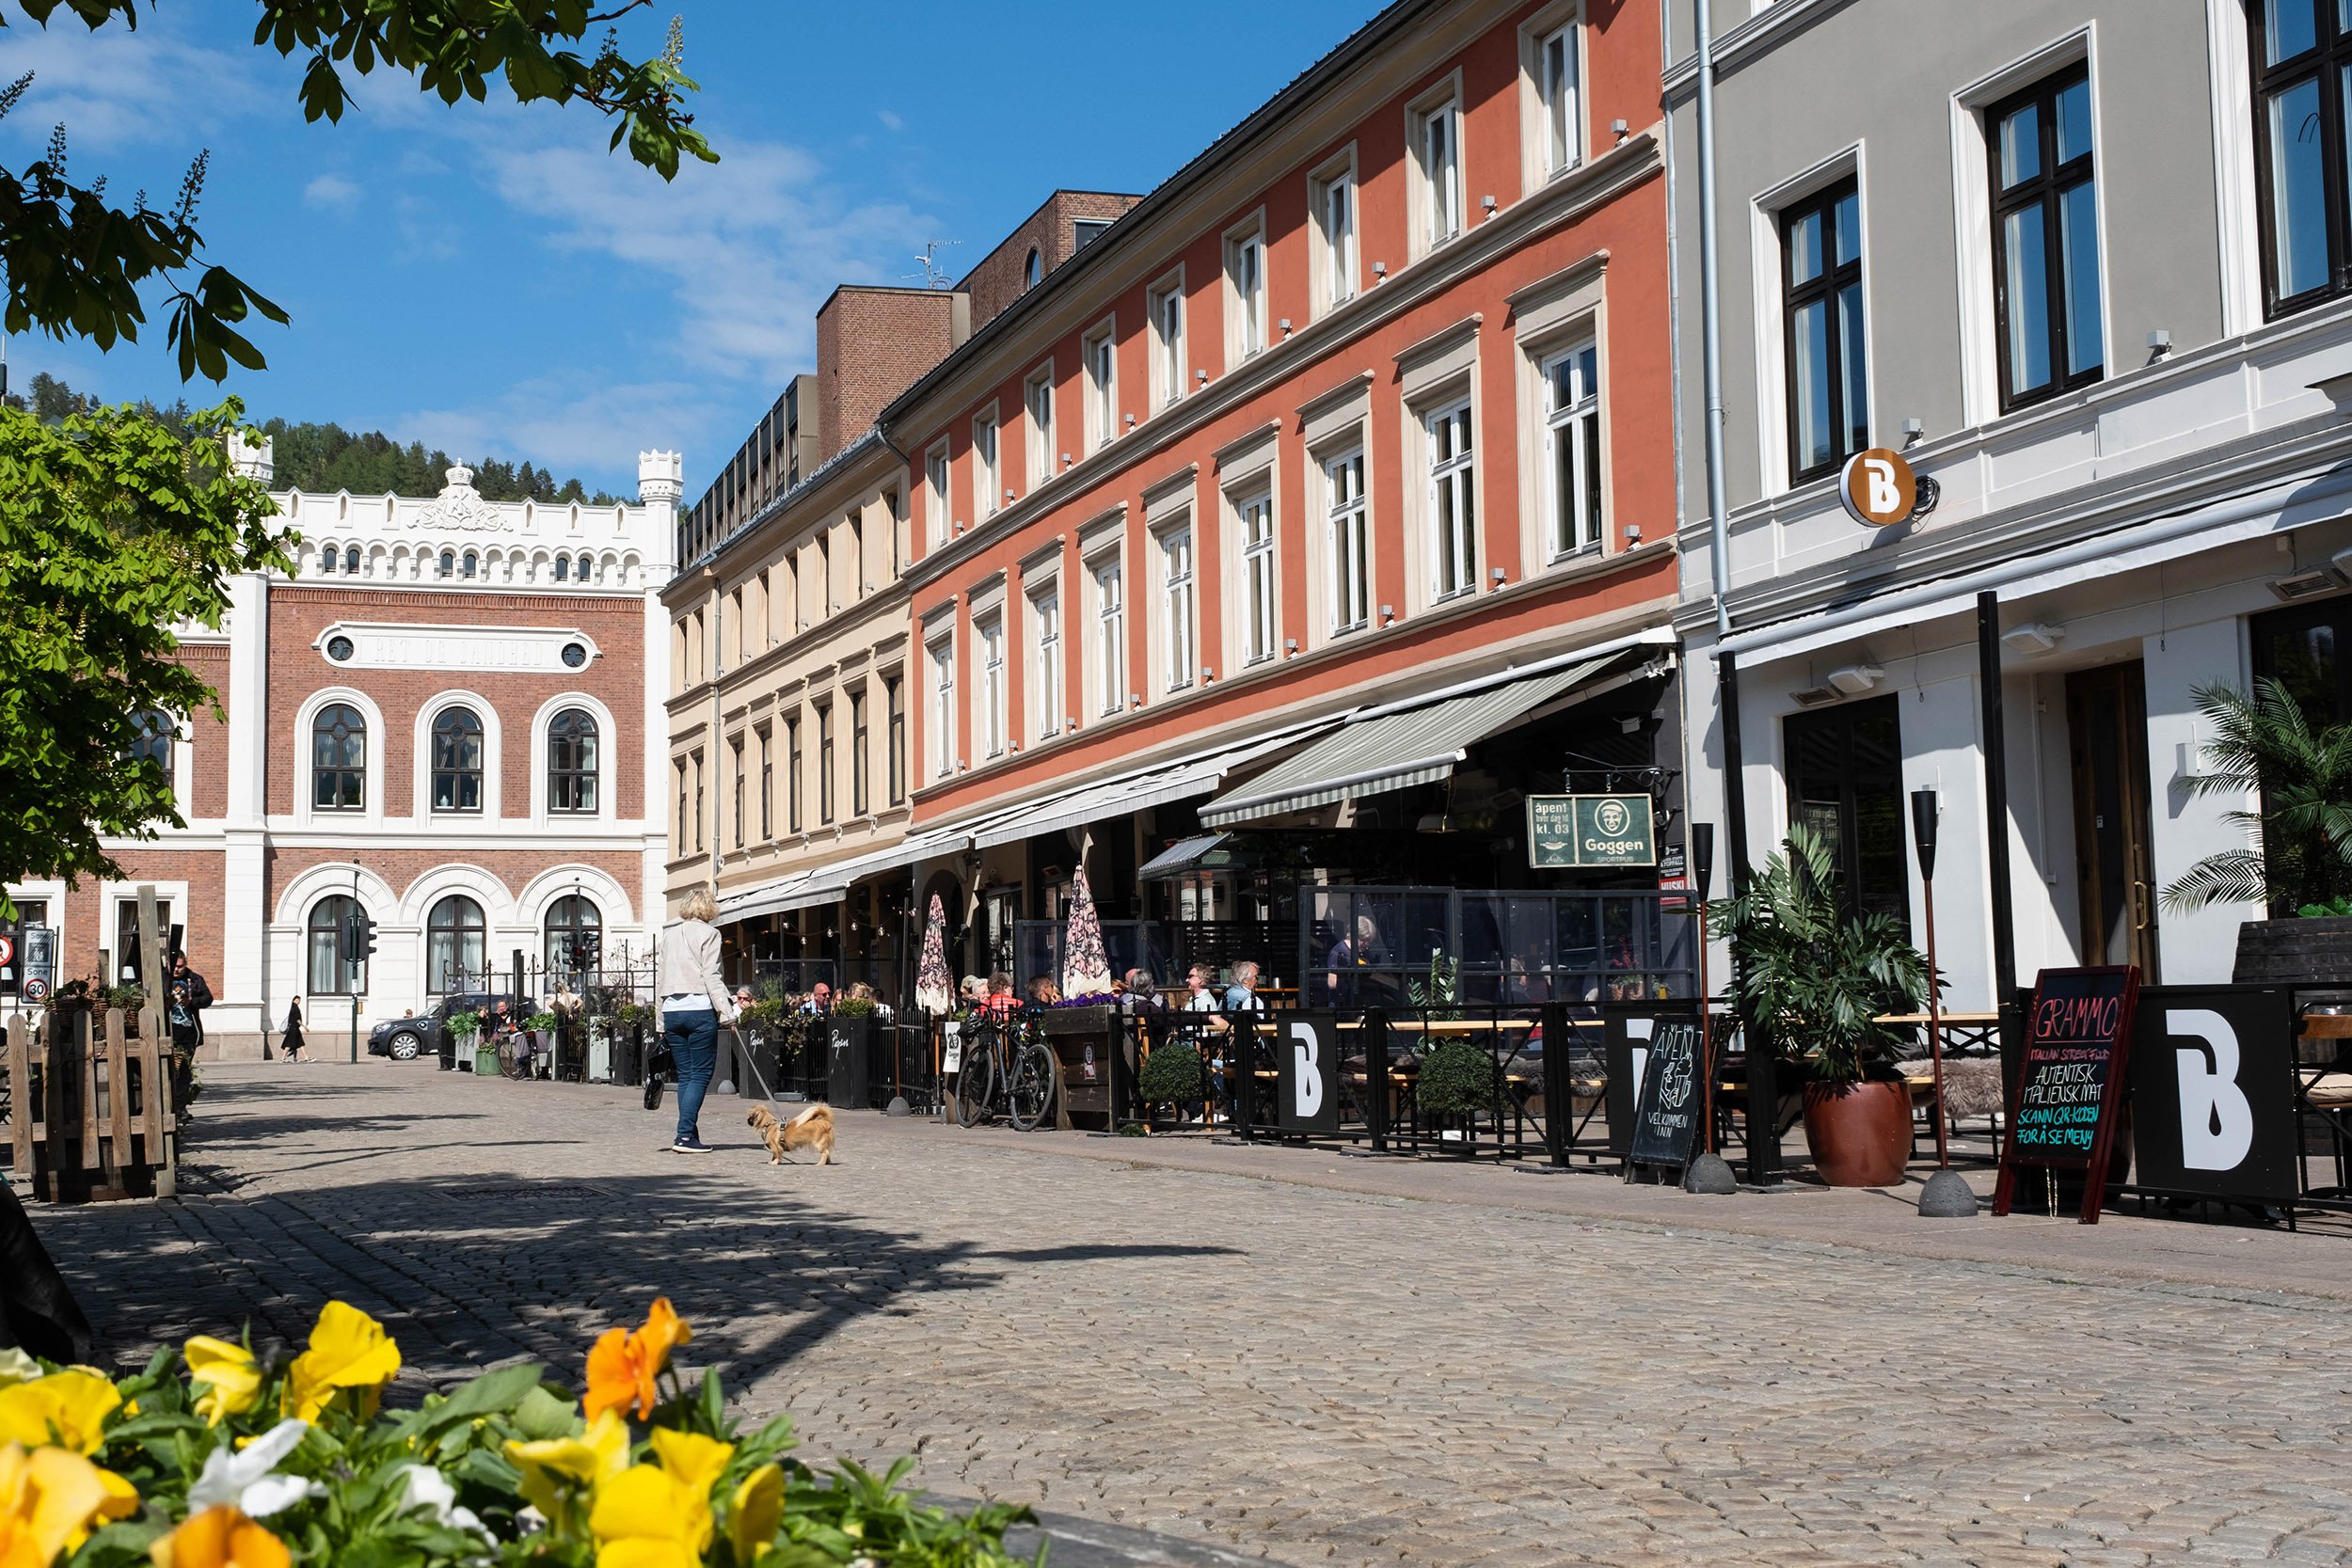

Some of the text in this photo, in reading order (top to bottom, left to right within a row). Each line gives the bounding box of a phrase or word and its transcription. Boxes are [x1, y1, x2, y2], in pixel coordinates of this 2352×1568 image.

[1864, 458, 1901, 514] B
[1535, 802, 1567, 816] åpent
[1536, 823, 1569, 834] kl. 03
[1584, 838, 1644, 855] Goggen
[29, 984, 44, 995] 30
[2036, 996, 2119, 1037] GRAMMO
[1651, 1026, 1704, 1060] ÅPENT
[2030, 1048, 2060, 1061] ITALIAN
[1290, 1022, 1324, 1117] B
[2035, 1063, 2097, 1085] AUTENTISK
[2023, 1083, 2105, 1105] ITALIENSK MAT
[2165, 1008, 2254, 1171] B
[1647, 1112, 1689, 1129] VELKOMMEN
[2017, 1107, 2053, 1126] SCANN
[2017, 1124, 2094, 1150] FOR Å SE MENY
